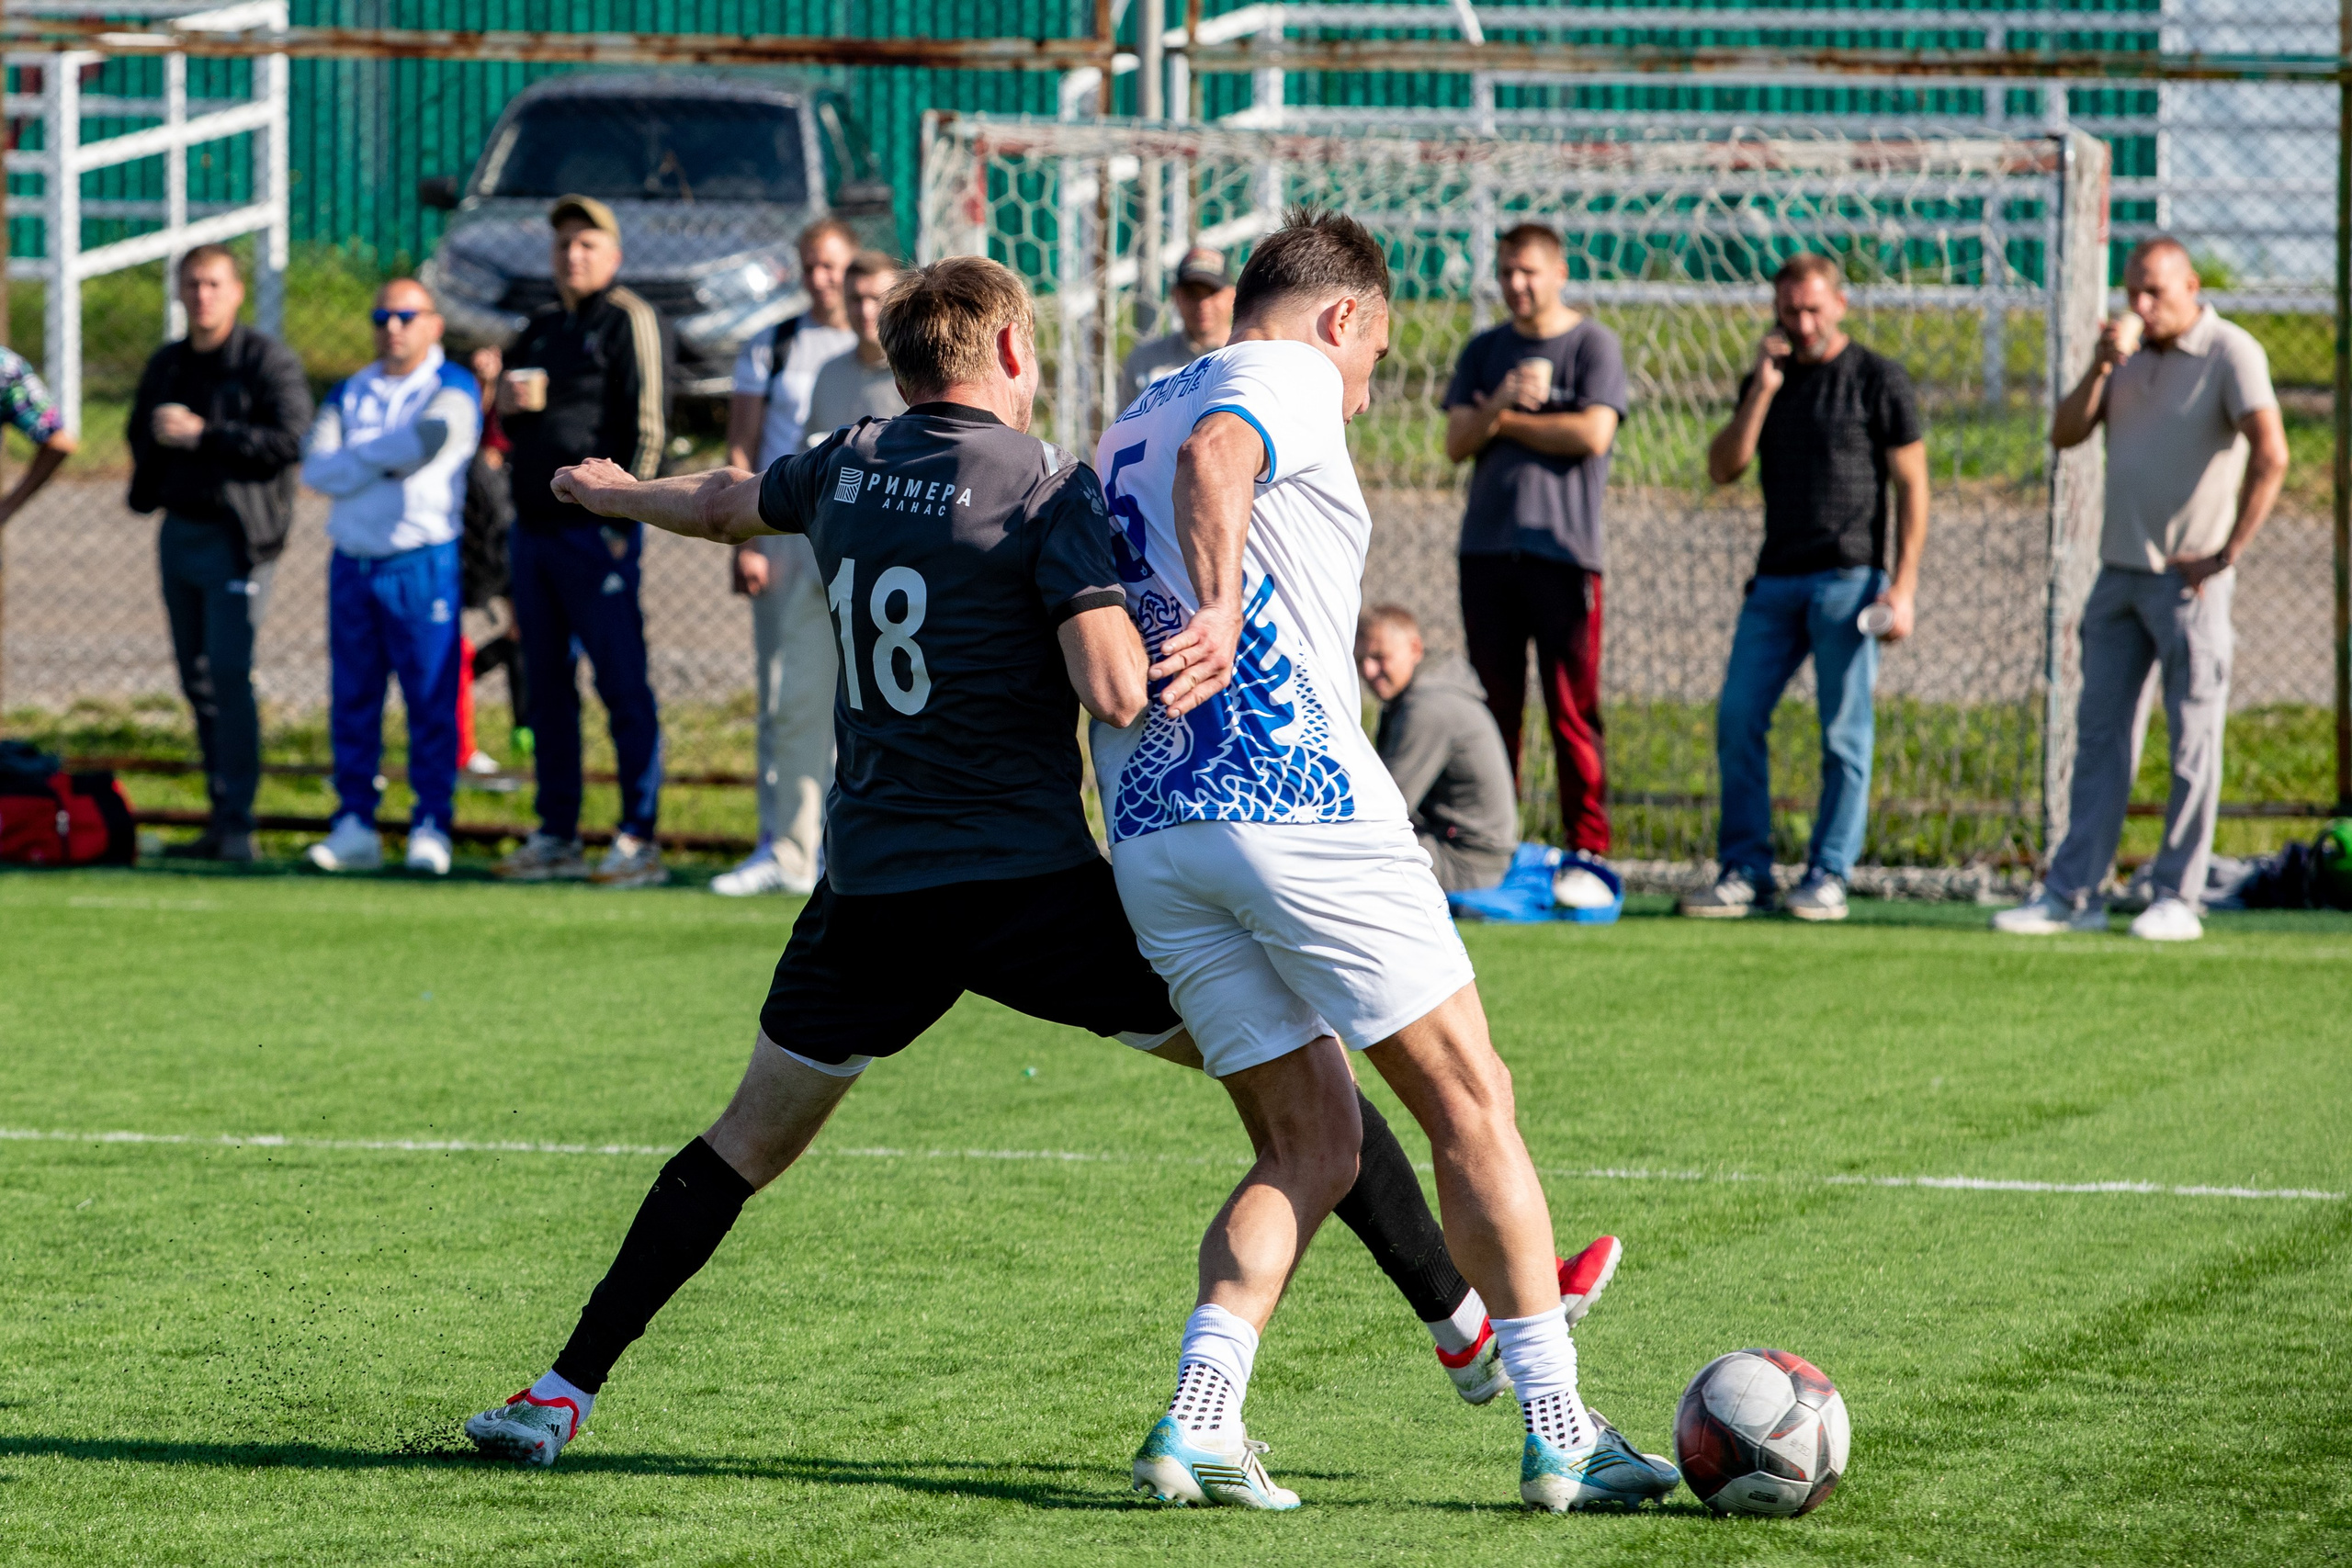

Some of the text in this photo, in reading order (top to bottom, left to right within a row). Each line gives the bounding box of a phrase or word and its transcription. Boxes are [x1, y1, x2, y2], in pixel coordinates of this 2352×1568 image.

[866, 473, 972, 507] РИМЕРА
[882, 498, 946, 516] АЛНАС
[1105, 439, 1156, 583] 5
[828, 557, 932, 716] 18
